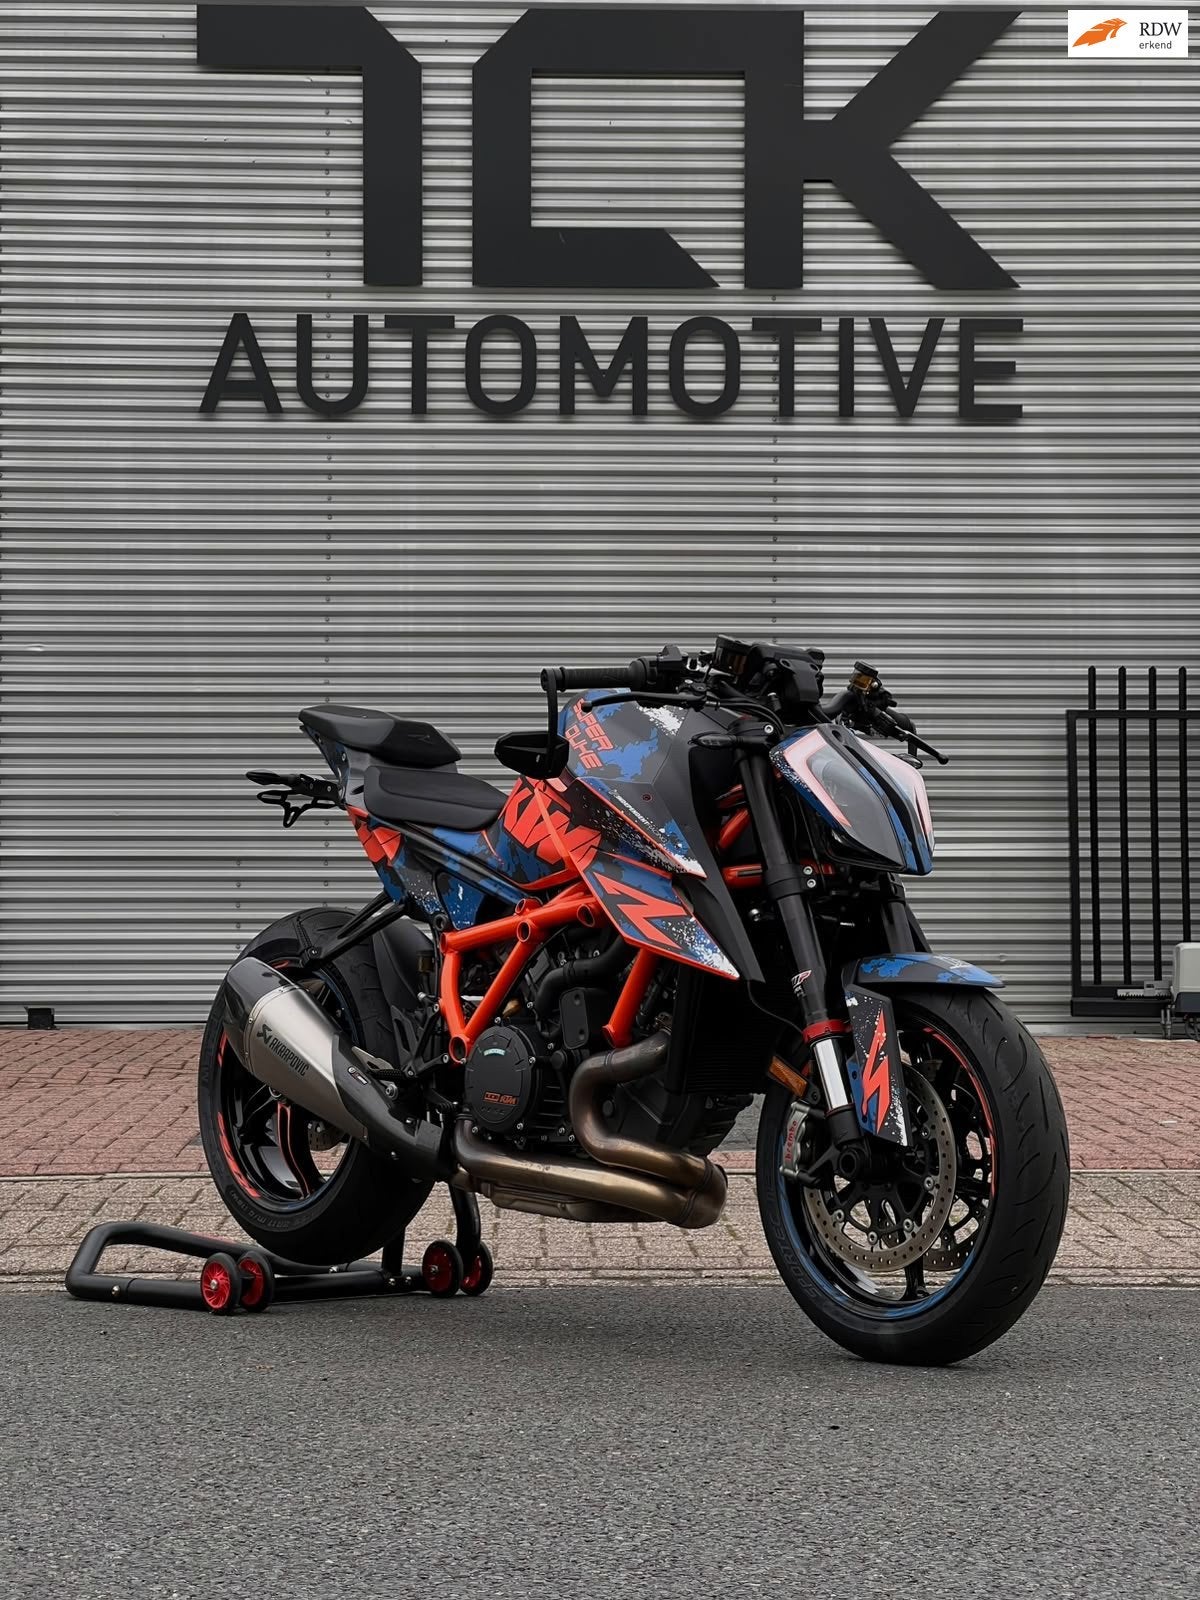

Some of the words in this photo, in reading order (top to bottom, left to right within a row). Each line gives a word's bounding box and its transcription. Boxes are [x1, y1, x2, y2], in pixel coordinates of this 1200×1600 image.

[200, 313, 1023, 419] AUTOMOTIVE
[565, 724, 603, 770] DUKE
[573, 698, 614, 752] SUPER
[784, 1119, 798, 1162] brembo
